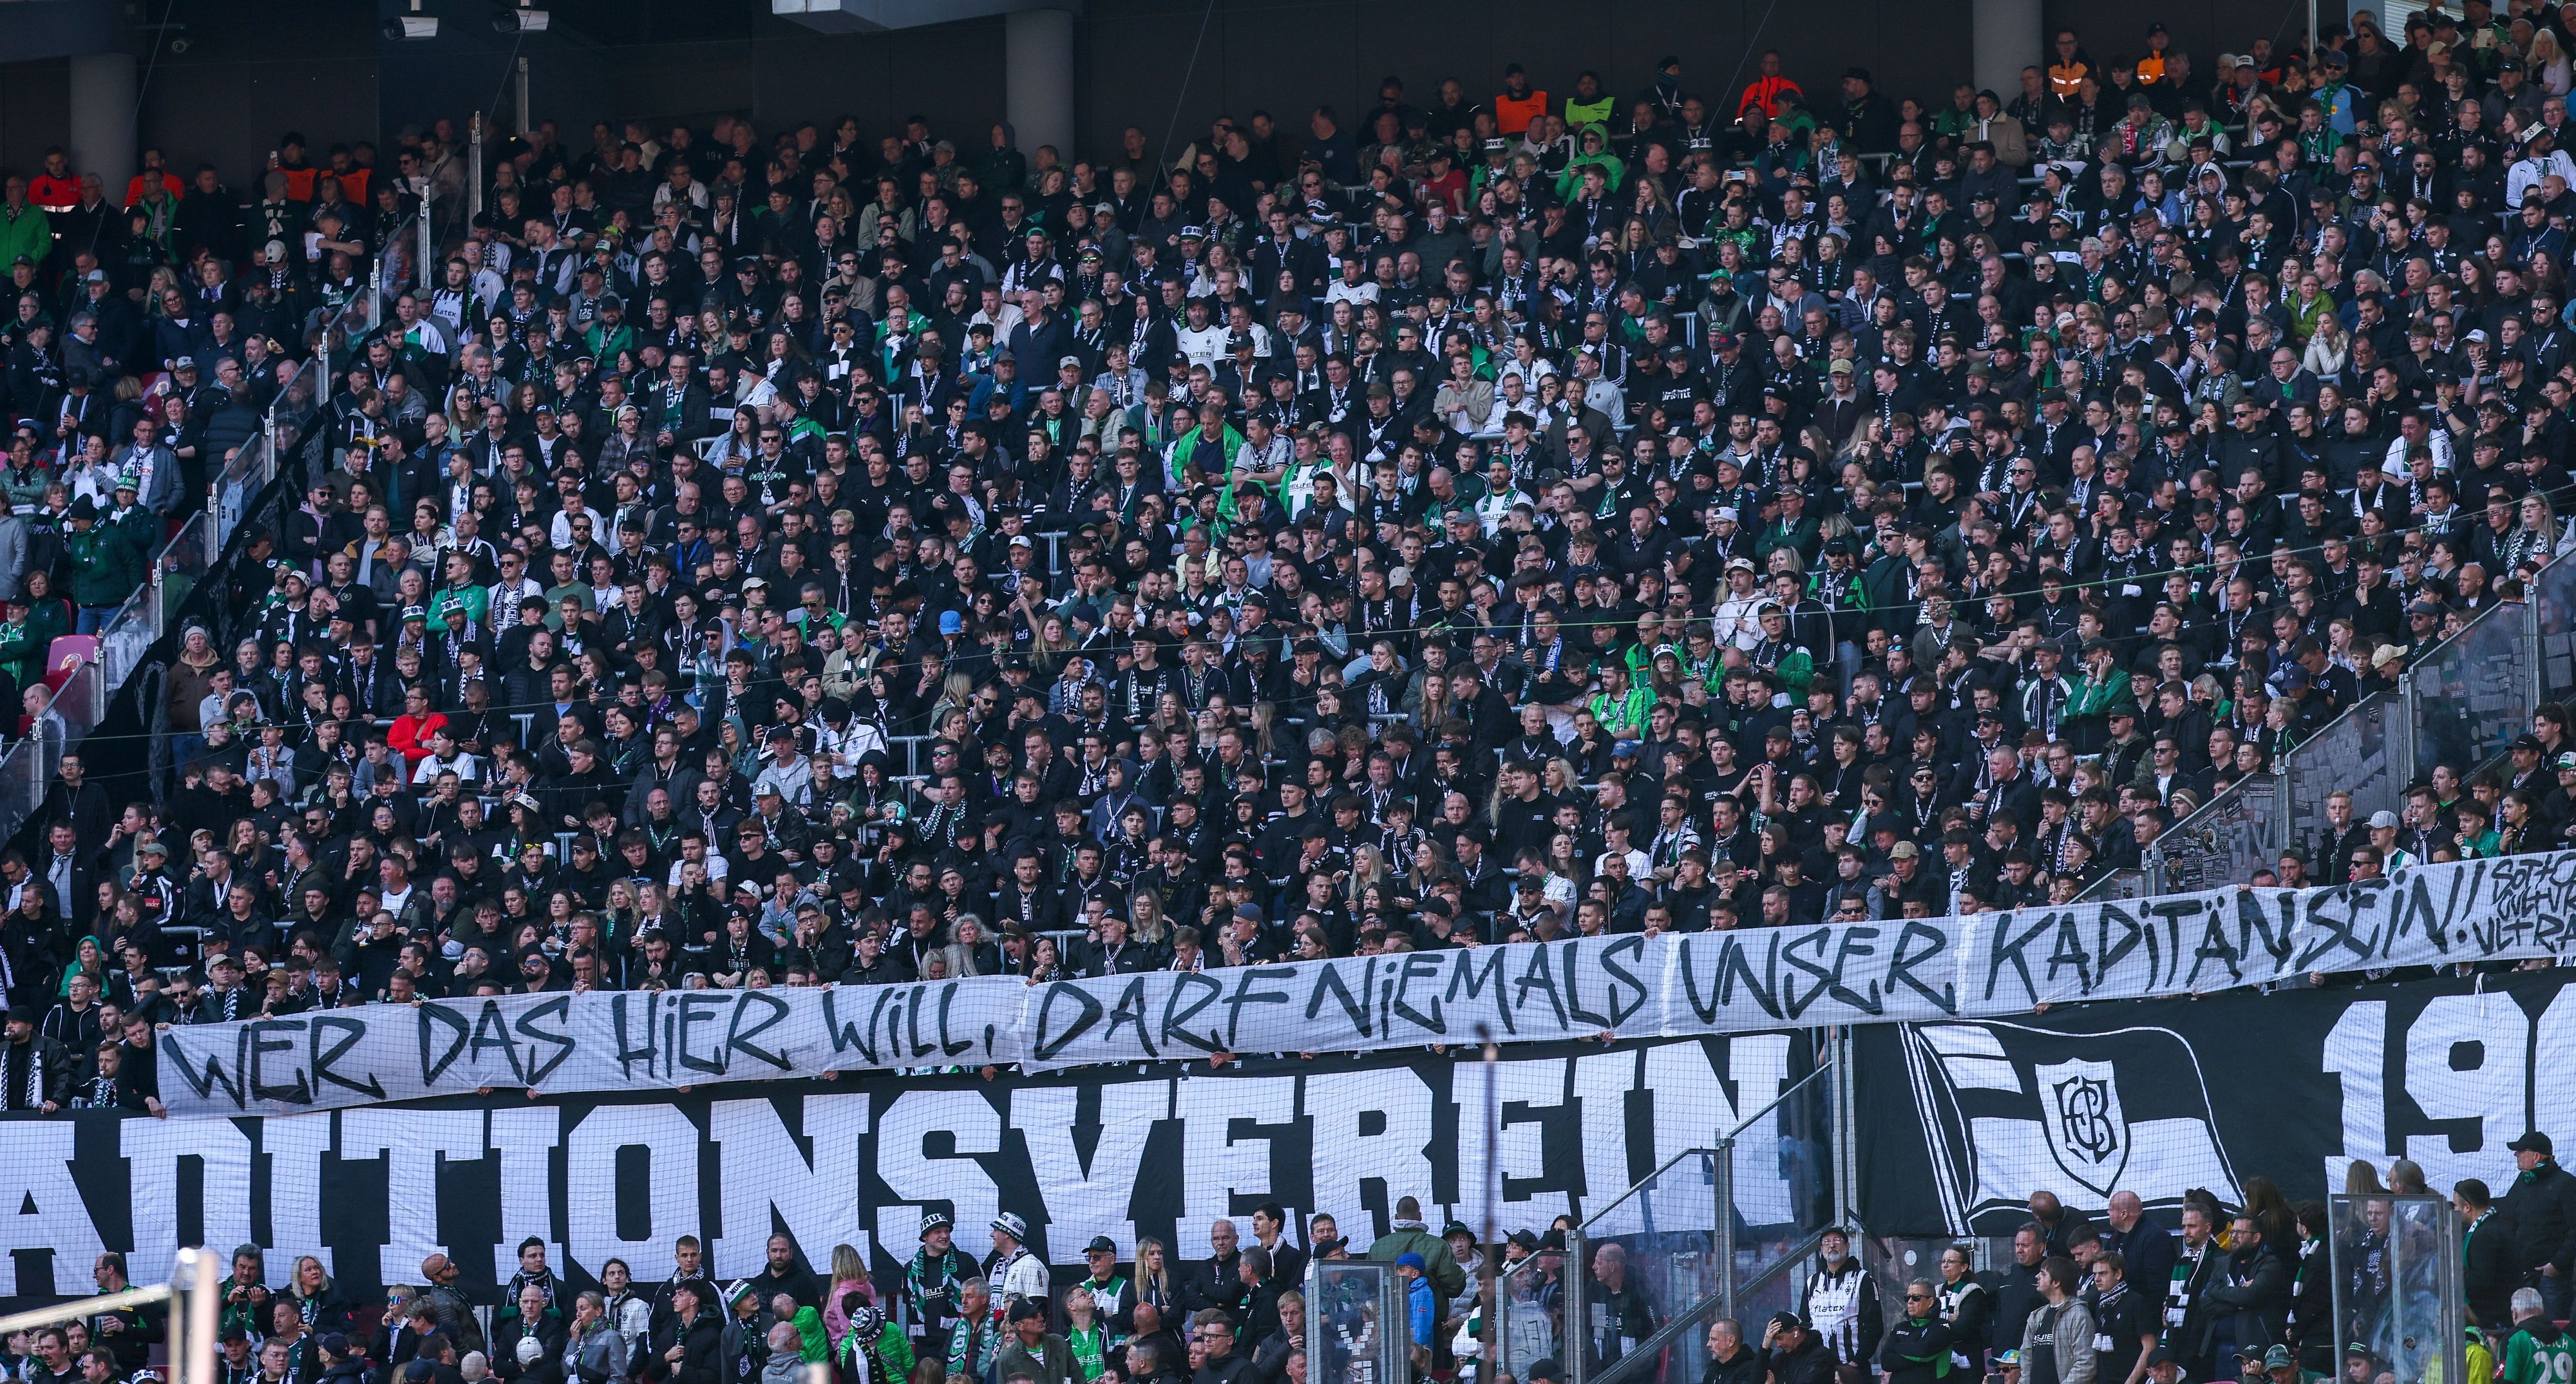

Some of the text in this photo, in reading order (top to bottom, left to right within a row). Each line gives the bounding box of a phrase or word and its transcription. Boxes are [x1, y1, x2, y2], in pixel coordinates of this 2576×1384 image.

[162, 1016, 386, 1111] WER
[419, 995, 576, 1086] DAS
[1034, 967, 1297, 1061] DARF
[1680, 921, 1956, 1024] UNSER
[1814, 1304, 1846, 1313] flatex
[2532, 1351, 2573, 1384] 29
